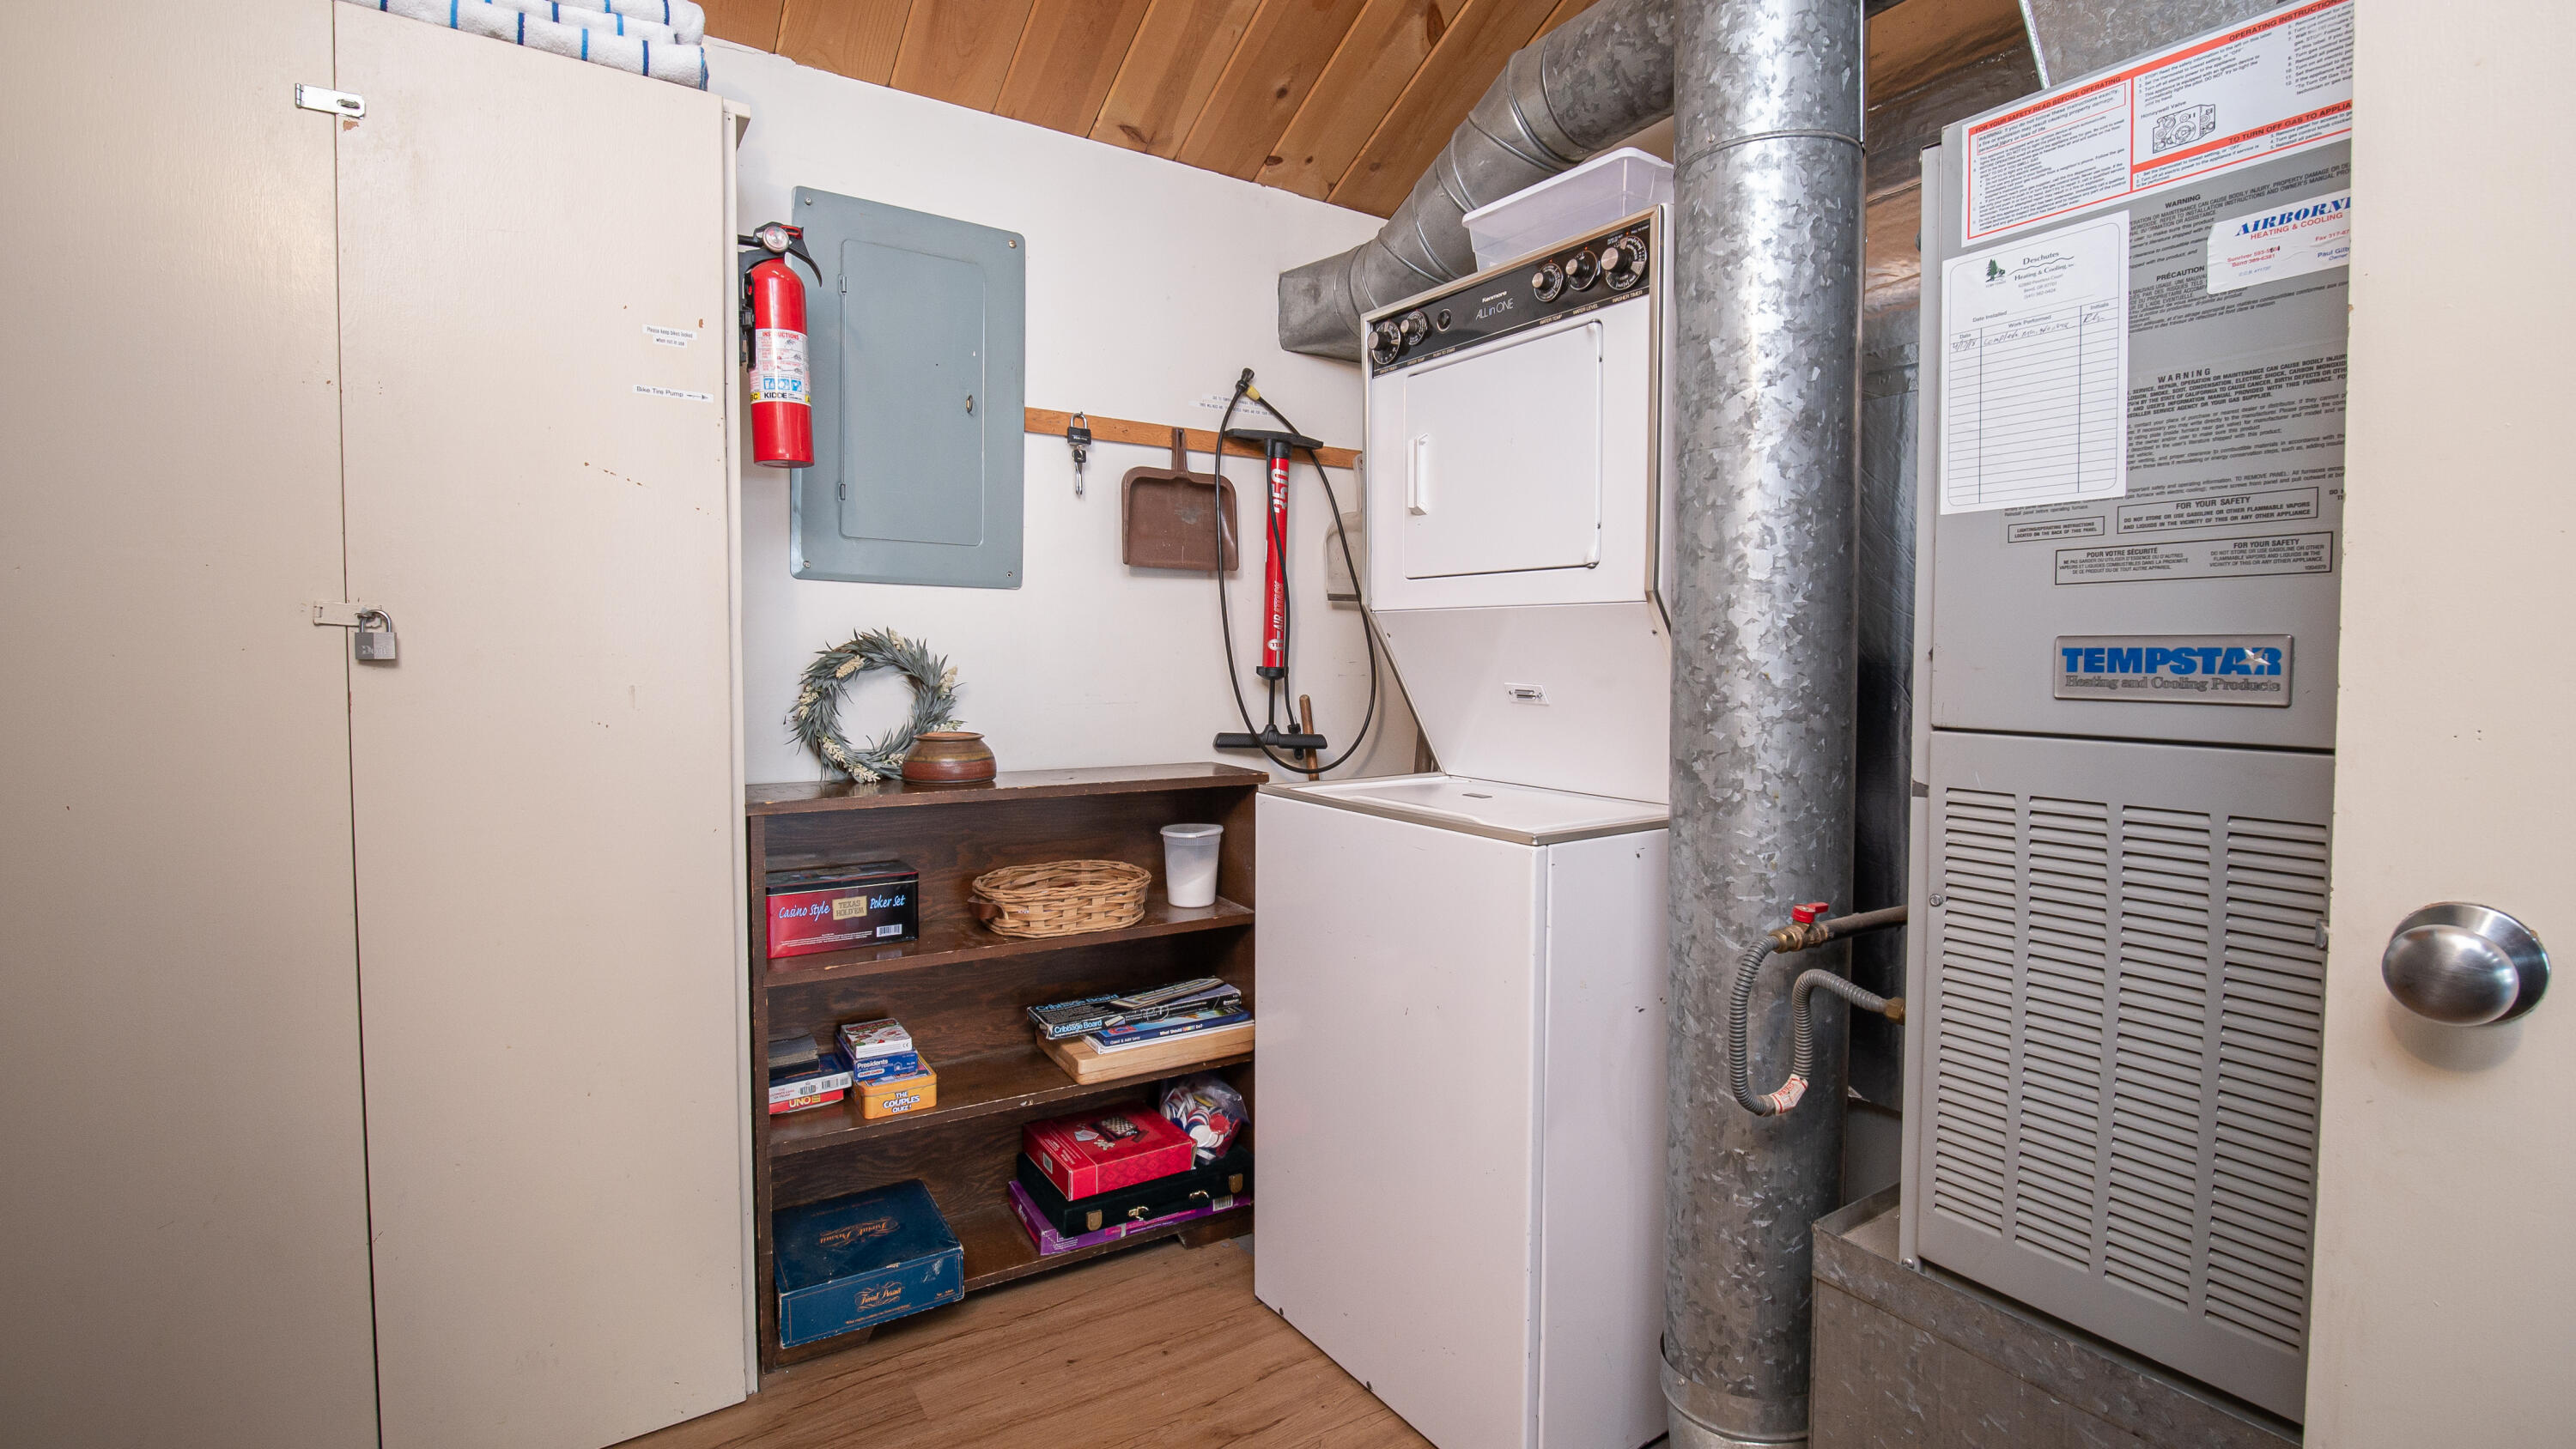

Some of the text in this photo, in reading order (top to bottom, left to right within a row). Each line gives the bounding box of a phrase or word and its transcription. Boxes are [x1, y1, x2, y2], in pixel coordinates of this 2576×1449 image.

[2229, 19, 2276, 42] OPERATING
[1975, 76, 2121, 134] FOR YOUR SAFETY READ BEFORE OPERATING
[2228, 101, 2352, 144] TO TURN OFF GAS TO APPLIA
[2165, 193, 2201, 209] WARNING
[2250, 224, 2289, 240] HEATING
[2300, 210, 2343, 228] COOLING
[2022, 251, 2059, 266] Deschutes
[2318, 245, 2349, 258] Paul Gilb
[2014, 270, 2037, 282] Heating
[2156, 265, 2205, 282] PRÉCAUTION
[1481, 290, 1508, 304] Kenmore
[1612, 289, 1643, 303] WASHER TIMER
[1475, 298, 1514, 321] ALL in ONE
[1572, 303, 1600, 315] WATER LEVEL
[1972, 310, 2008, 323] Date Installed
[2008, 315, 2052, 328] Work Performed
[762, 330, 799, 341] INSUCTIONS
[665, 389, 684, 397] Pump
[2176, 495, 2251, 510] FOR YOUR SAFETY
[2271, 538, 2300, 547] SAFETY
[2126, 547, 2158, 555] SÉCURITÉ
[1273, 614, 1285, 632] AIR
[2061, 646, 2281, 676] TEMPSTAR
[2065, 675, 2281, 693] Heating and Cooling Products
[838, 900, 861, 909] TEXAS
[869, 894, 907, 910] Poker Set
[778, 900, 831, 922] Casino Style
[835, 907, 865, 918] HOLD'EM
[1035, 993, 1119, 1011] Cribbage Board
[1054, 1019, 1103, 1034] Cribbage Board
[857, 1059, 889, 1069] Presidents
[788, 1095, 811, 1108] UNO
[883, 1094, 920, 1109] COUPLES
[894, 1091, 909, 1100] THE
[891, 1104, 912, 1114] QUIZ!
